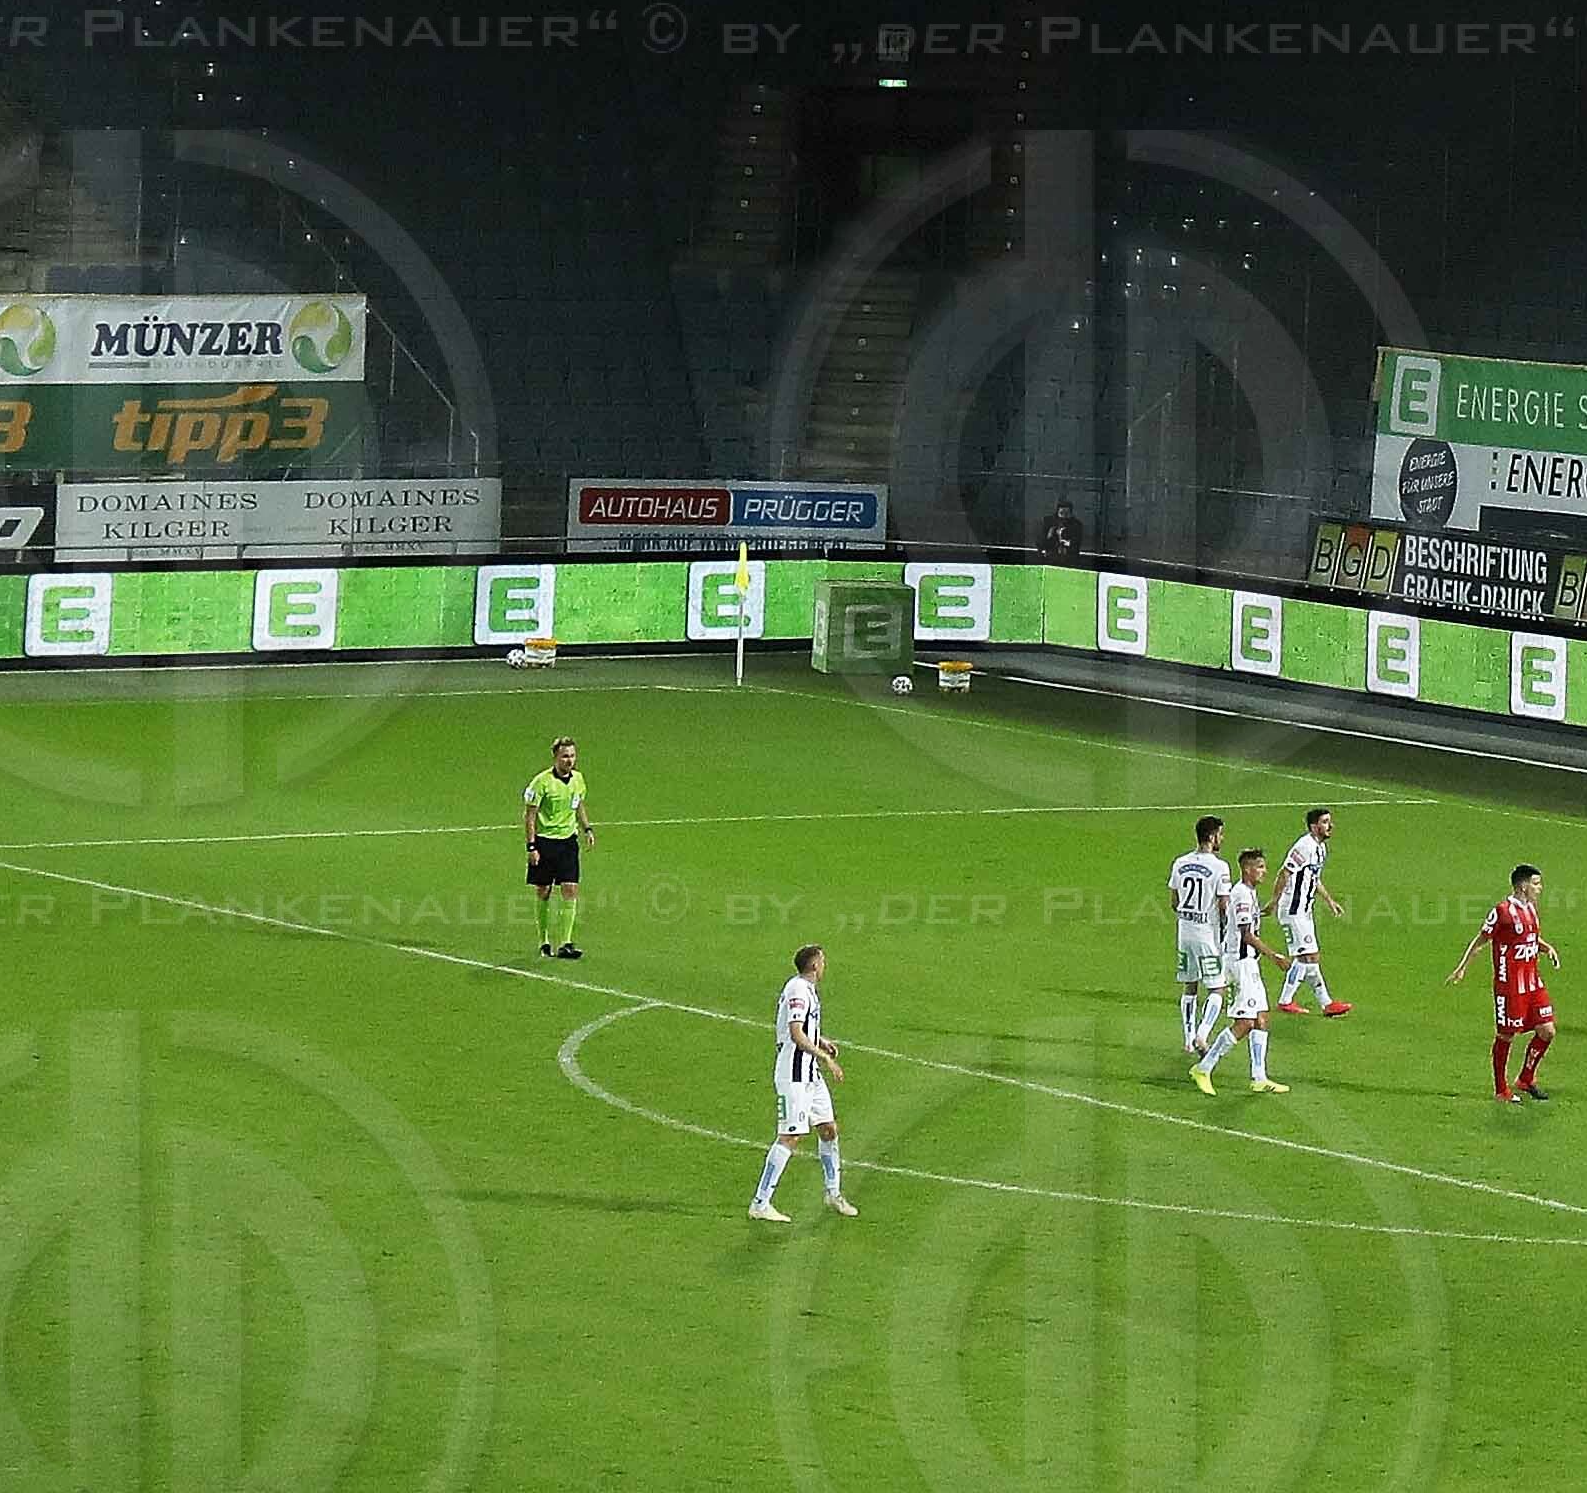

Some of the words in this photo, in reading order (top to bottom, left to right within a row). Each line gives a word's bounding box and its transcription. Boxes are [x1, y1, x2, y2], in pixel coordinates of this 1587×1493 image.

[90, 315, 283, 357] MÜNZER
[112, 390, 329, 464] tipp3
[1455, 382, 1565, 429] ENERGIE
[75, 492, 259, 514] DOMAINES
[303, 487, 482, 510] DOMAINES
[327, 515, 454, 536] KILGER
[588, 496, 720, 519] AUTOHAUS
[743, 497, 866, 523] PRÜGGER
[101, 519, 231, 540] KILGER
[1315, 537, 1393, 583] BGD
[1403, 533, 1549, 586] BESCHRIFTUNG
[41, 587, 97, 643] E
[268, 581, 322, 637] E
[488, 577, 540, 632] E
[701, 572, 750, 628] E
[918, 574, 976, 629] E
[1107, 585, 1139, 642] E
[1240, 604, 1272, 662] E
[1376, 625, 1410, 684] E
[1521, 646, 1556, 707] E
[1182, 876, 1203, 912] 21
